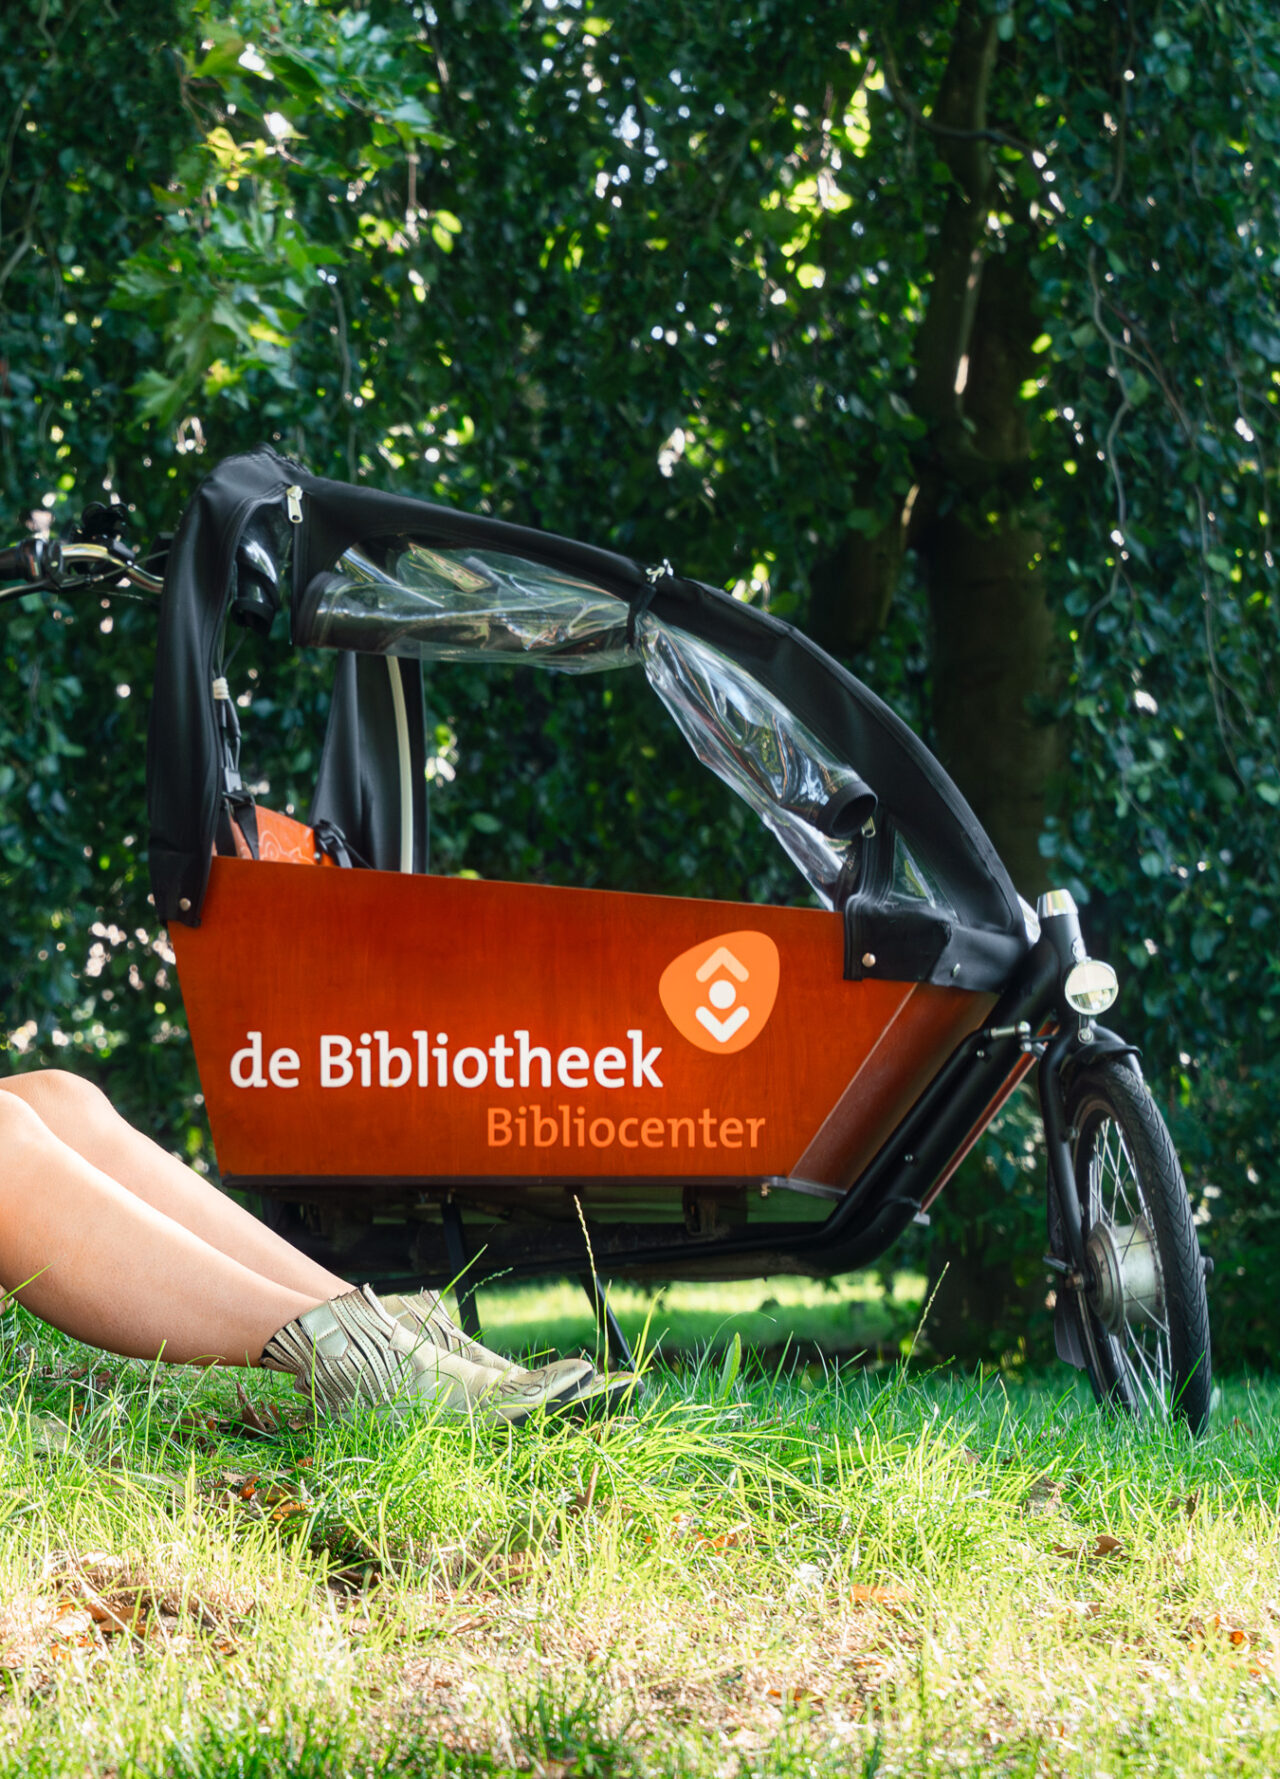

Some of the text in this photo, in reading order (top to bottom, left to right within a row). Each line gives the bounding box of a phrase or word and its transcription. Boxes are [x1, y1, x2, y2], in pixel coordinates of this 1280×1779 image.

[230, 1030, 664, 1088] de Bibliotheek
[487, 1105, 766, 1149] Bibliocenter
